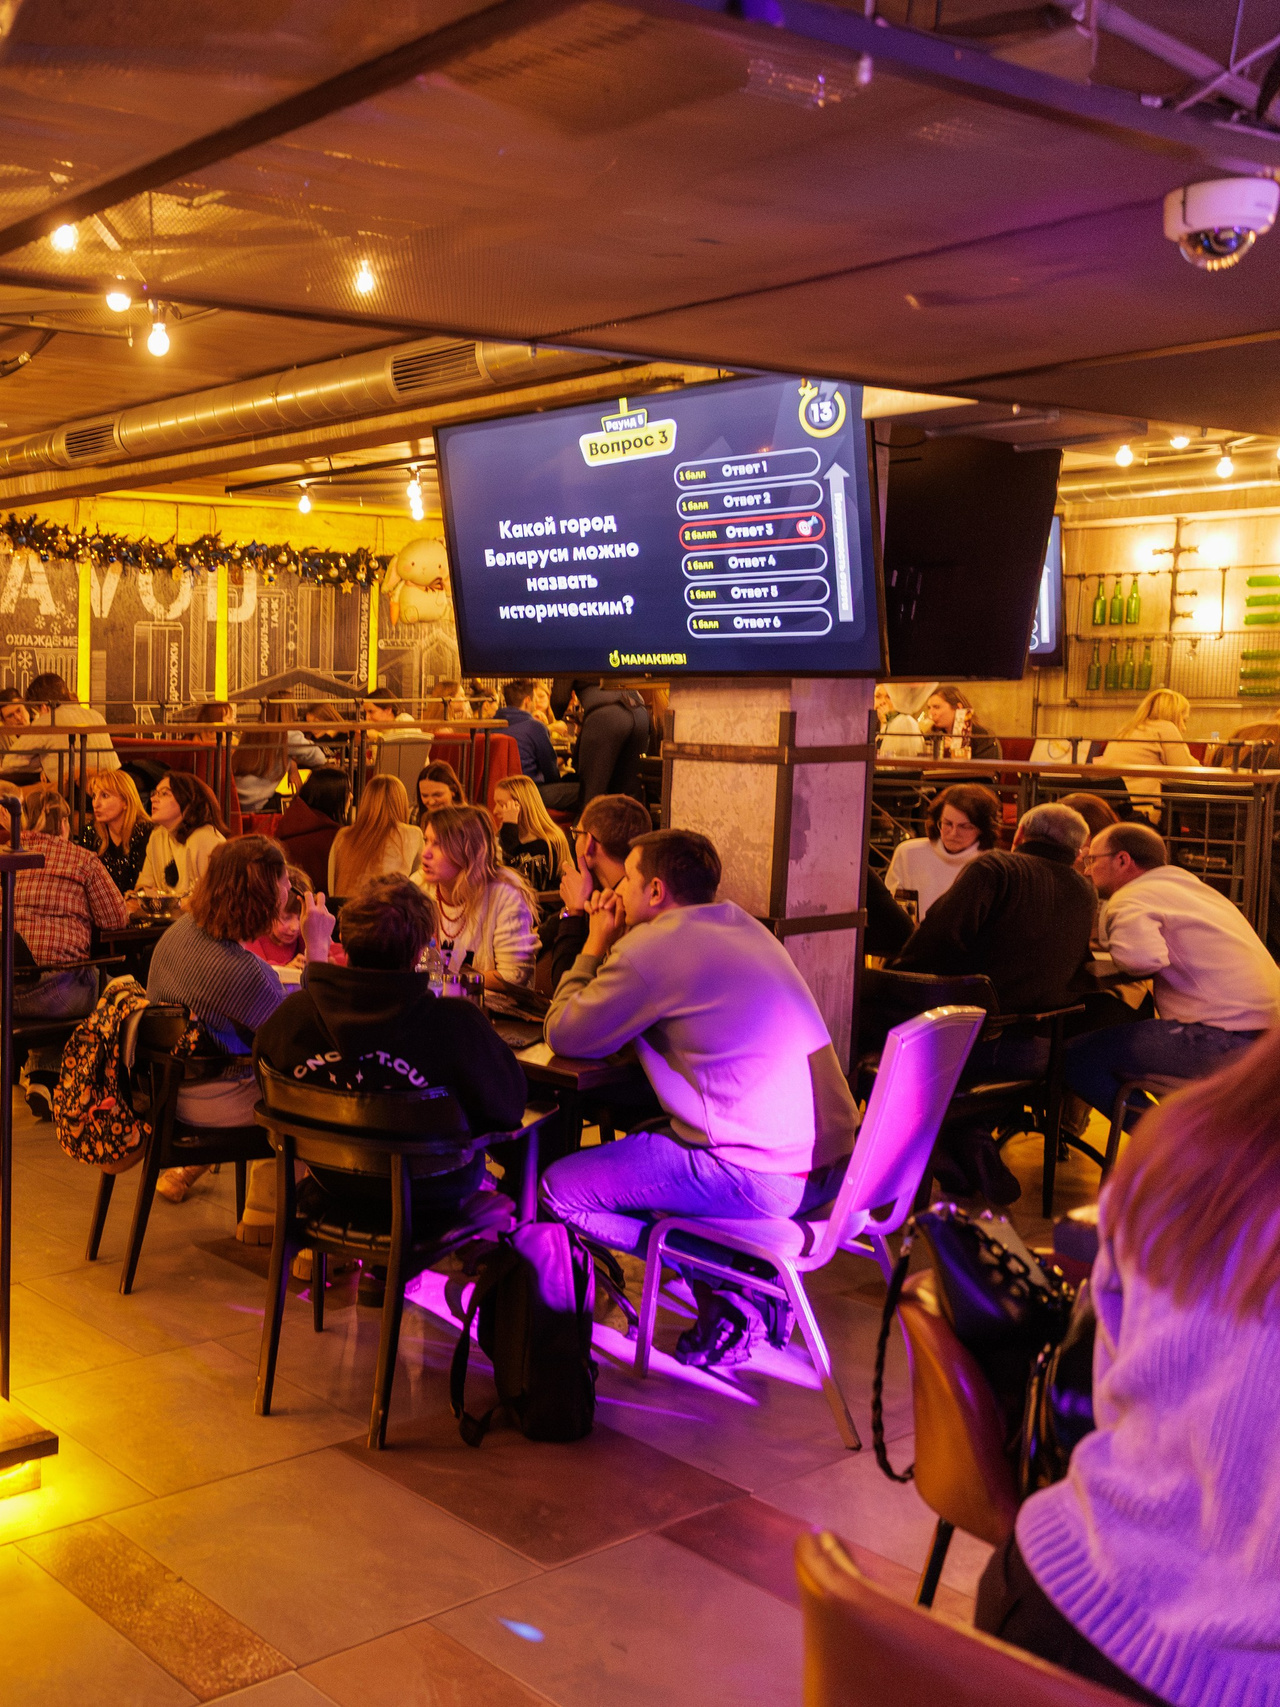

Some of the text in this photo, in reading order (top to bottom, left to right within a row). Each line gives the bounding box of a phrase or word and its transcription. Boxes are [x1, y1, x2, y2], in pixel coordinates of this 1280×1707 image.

[810, 401, 832, 422] 13
[605, 417, 637, 432] Раунд
[589, 430, 668, 456] Вопрос 3
[679, 460, 767, 481] 1 балл Ответ 1
[682, 491, 771, 512] 1 балл Ответ 2
[499, 515, 618, 539] Какой город
[684, 523, 774, 540] 2 балла Ответ 3
[484, 542, 640, 569] Беларуси можно
[687, 554, 776, 570] 1 балл Ответ 4
[526, 574, 598, 592] назвать
[690, 585, 778, 600] 1 балл Ответ 5
[270, 598, 278, 628] ТАНК
[499, 595, 634, 623] историческим?
[692, 616, 781, 630] 1 балл Ответ 6
[6, 634, 78, 648] ОХЛАЖДЕНИЕ
[170, 642, 179, 701] ДРОЖЖИ
